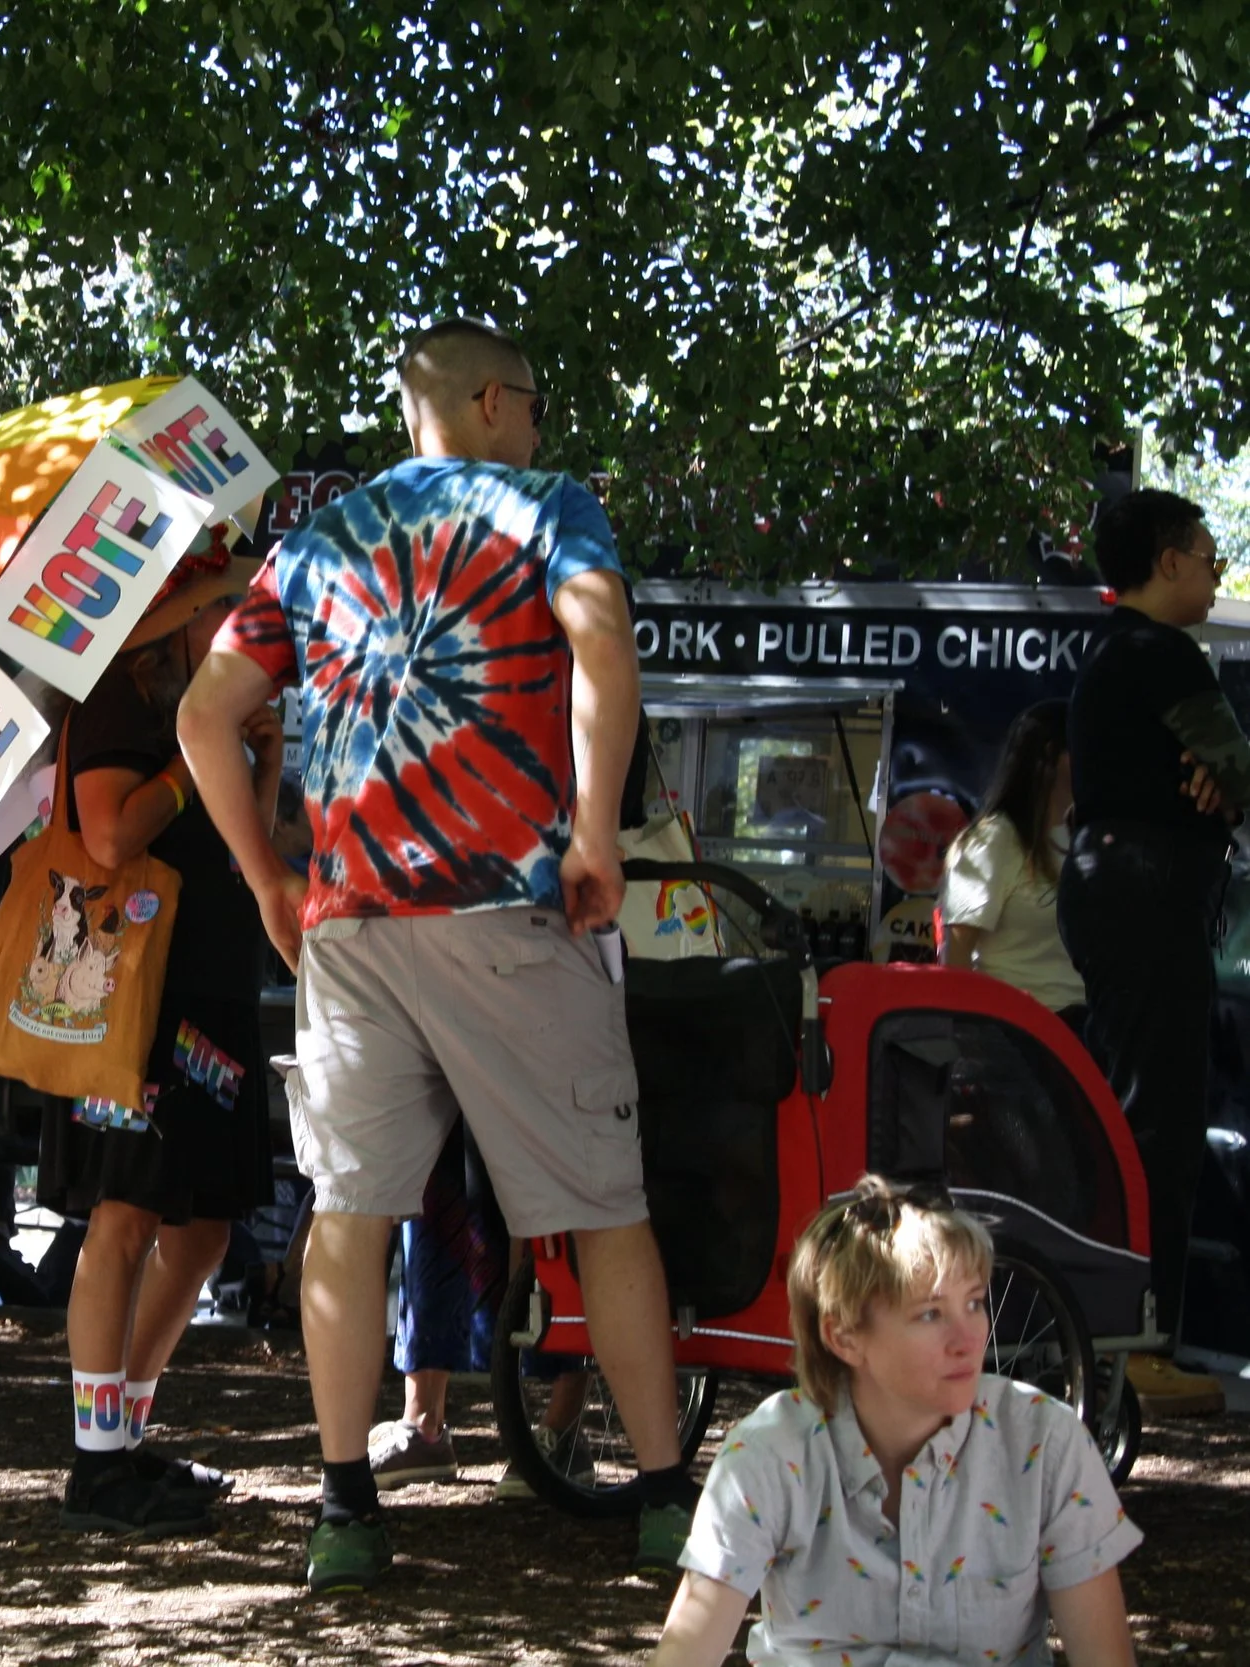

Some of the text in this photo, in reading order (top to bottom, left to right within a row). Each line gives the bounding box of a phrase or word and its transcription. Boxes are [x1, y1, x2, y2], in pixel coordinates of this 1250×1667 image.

[138, 404, 249, 498] VOTE
[8, 480, 173, 656] VOTE
[758, 622, 921, 666] PULLED
[937, 625, 1093, 671] CHICK
[55, 1031, 101, 1039] commodities
[173, 1017, 246, 1112] VOTE
